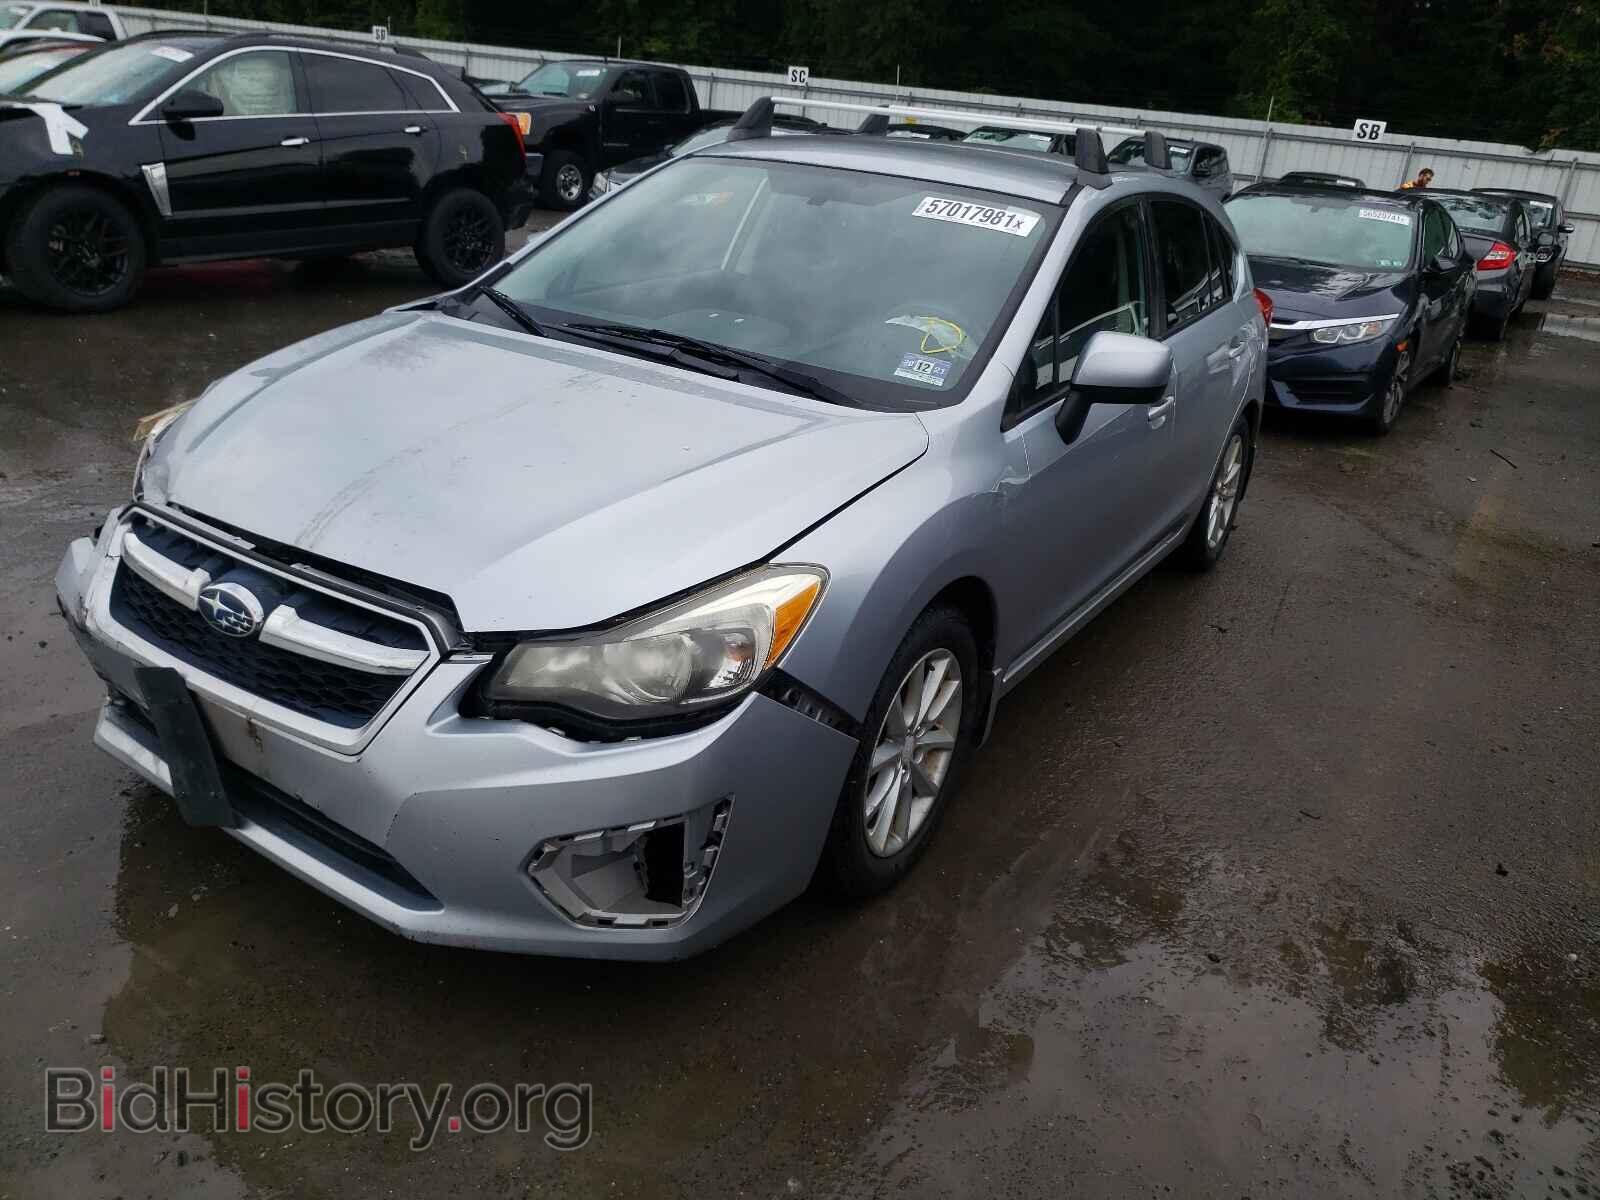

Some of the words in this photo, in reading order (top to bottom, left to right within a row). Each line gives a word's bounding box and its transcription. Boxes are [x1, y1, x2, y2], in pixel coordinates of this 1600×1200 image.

[791, 69, 806, 83] SC
[1357, 123, 1380, 140] SB
[917, 362, 931, 372] 12
